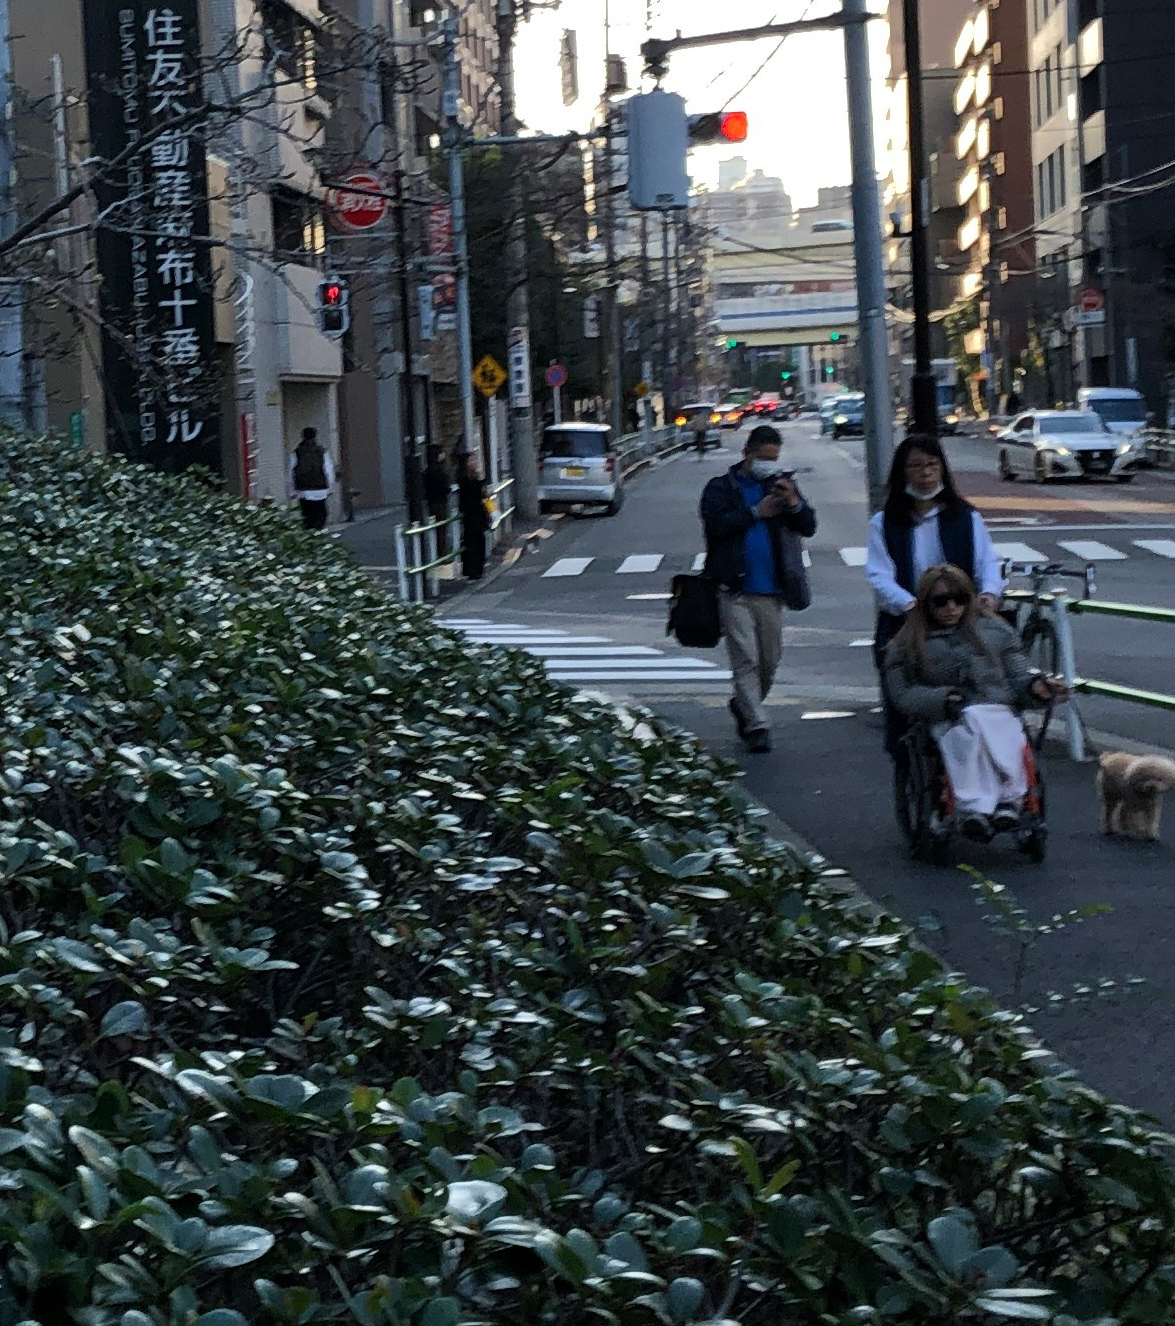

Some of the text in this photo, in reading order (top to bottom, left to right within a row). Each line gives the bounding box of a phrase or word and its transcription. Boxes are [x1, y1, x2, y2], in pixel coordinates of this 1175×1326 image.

[143, 8, 204, 443] 住友不動産麻布十番ビル
